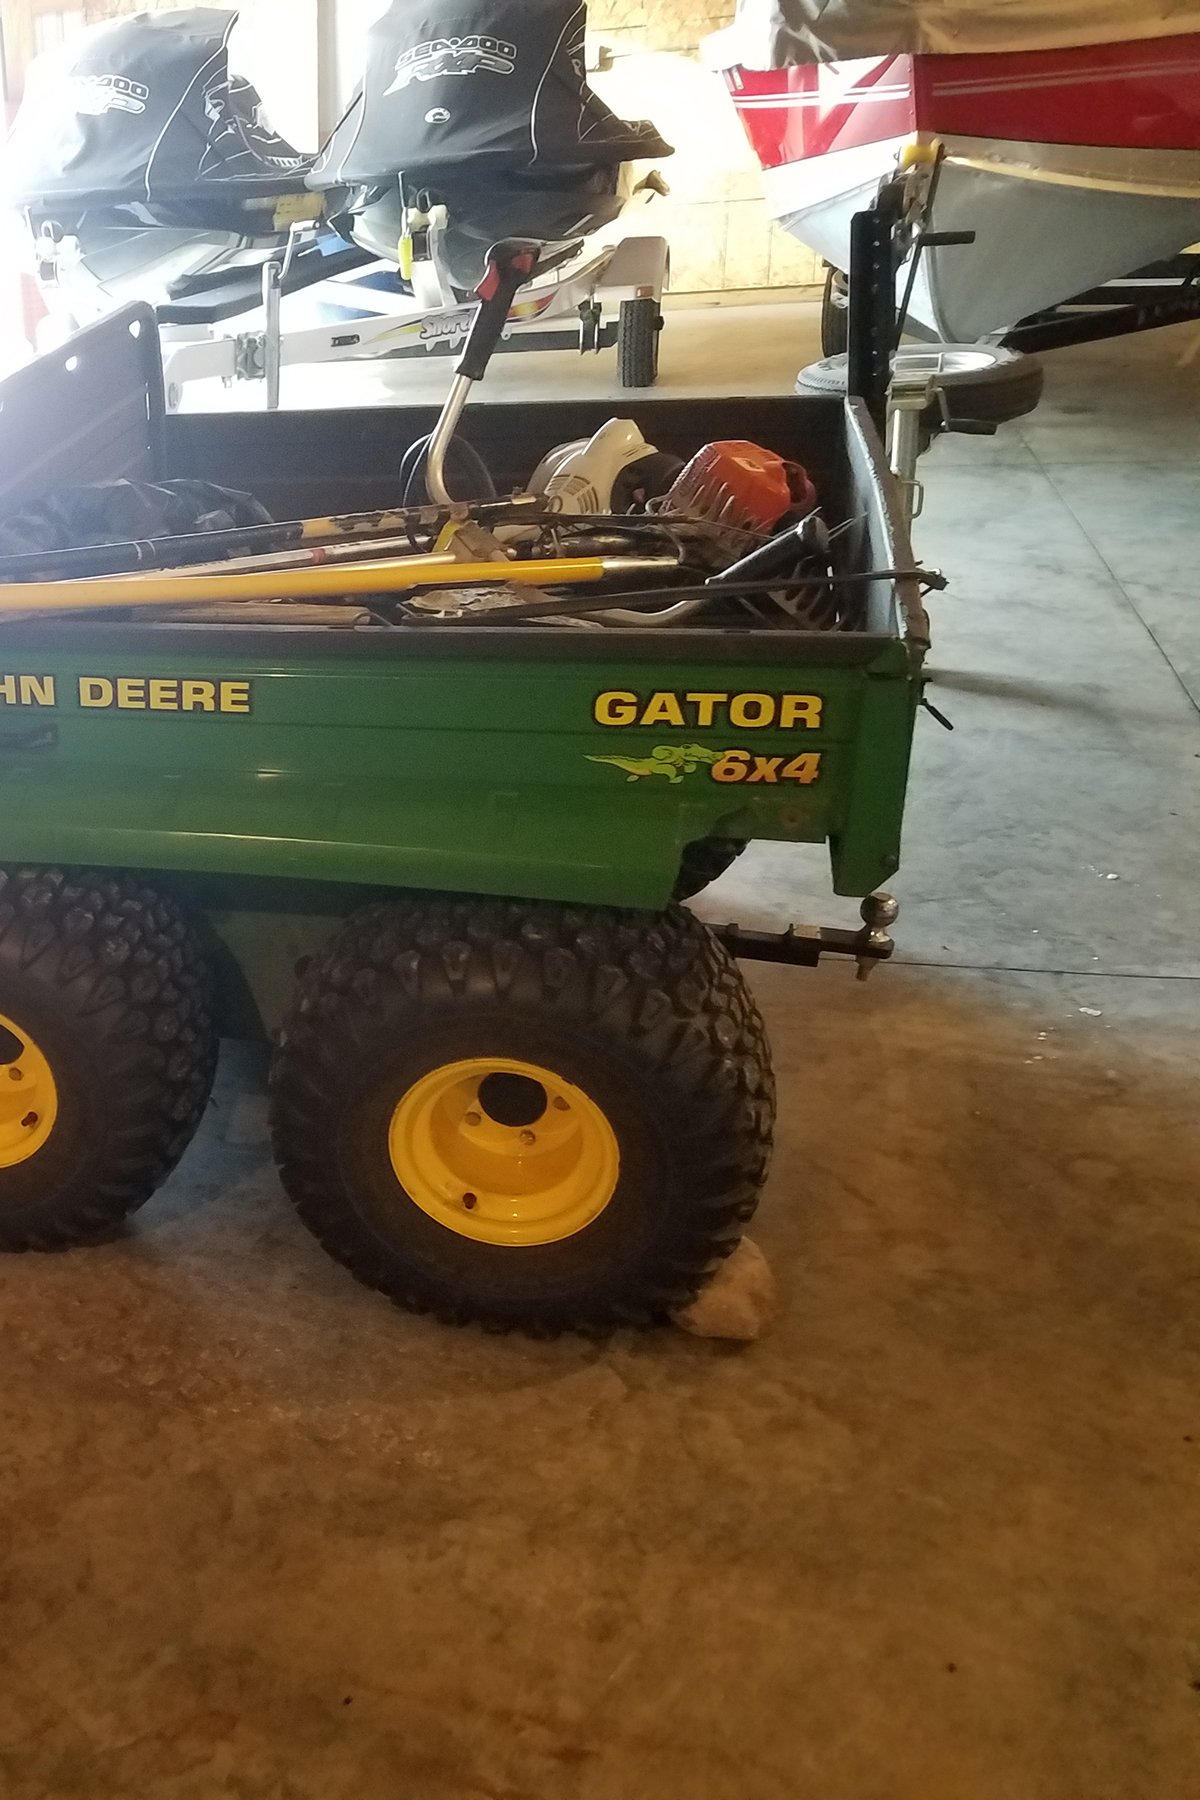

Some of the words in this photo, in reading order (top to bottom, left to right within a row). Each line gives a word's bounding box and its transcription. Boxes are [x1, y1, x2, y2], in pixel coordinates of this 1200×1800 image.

[78, 676, 251, 713] DEERE
[593, 690, 824, 729] GATOR
[710, 749, 823, 785] 6x4
